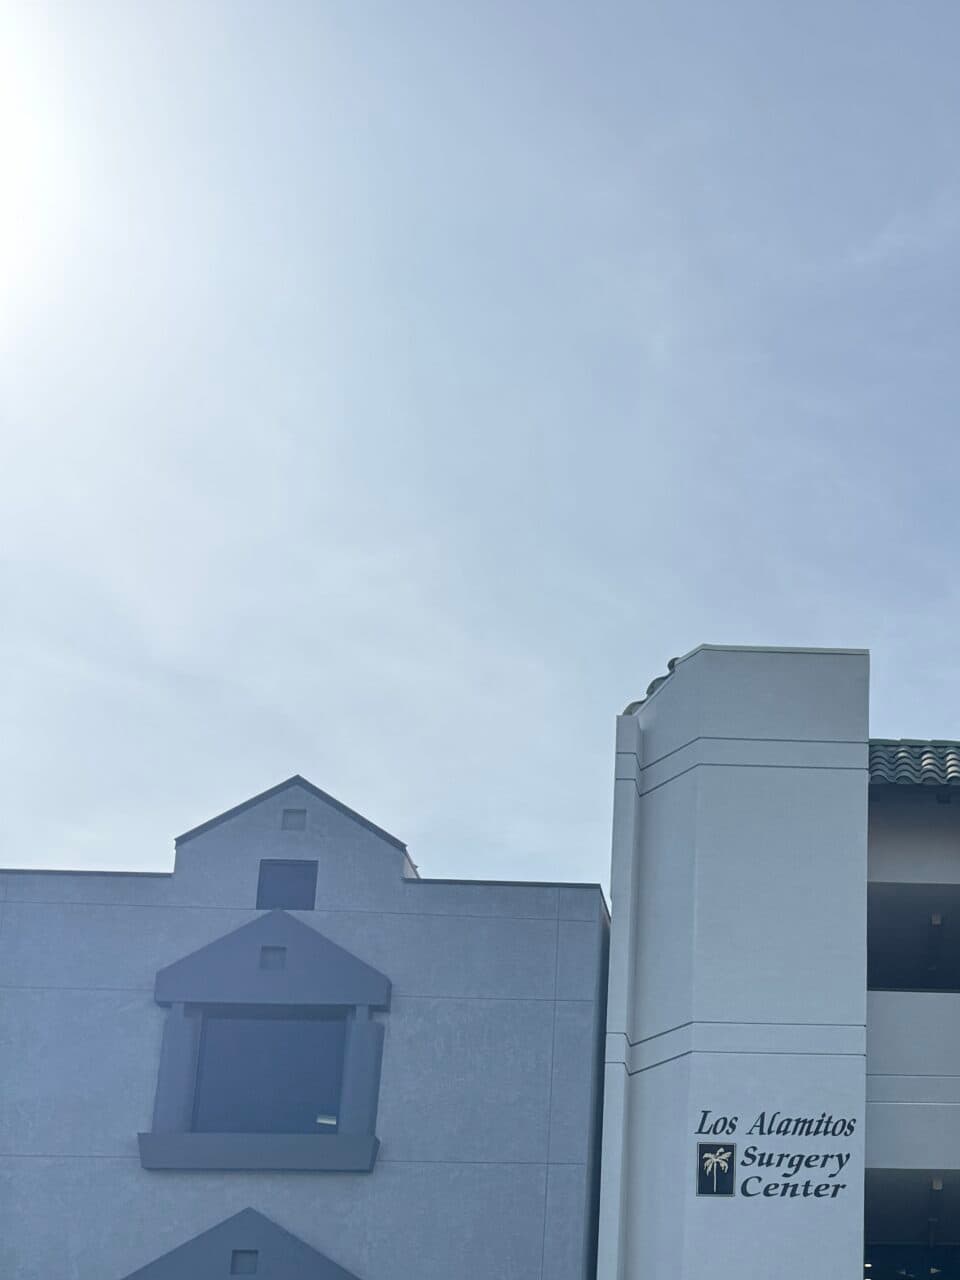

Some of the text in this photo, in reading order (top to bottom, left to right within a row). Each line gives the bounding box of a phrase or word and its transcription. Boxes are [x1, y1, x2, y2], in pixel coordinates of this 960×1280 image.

[695, 1110, 857, 1137] Los Alamitos
[740, 1145, 851, 1177] Surgery
[740, 1175, 847, 1199] Center
